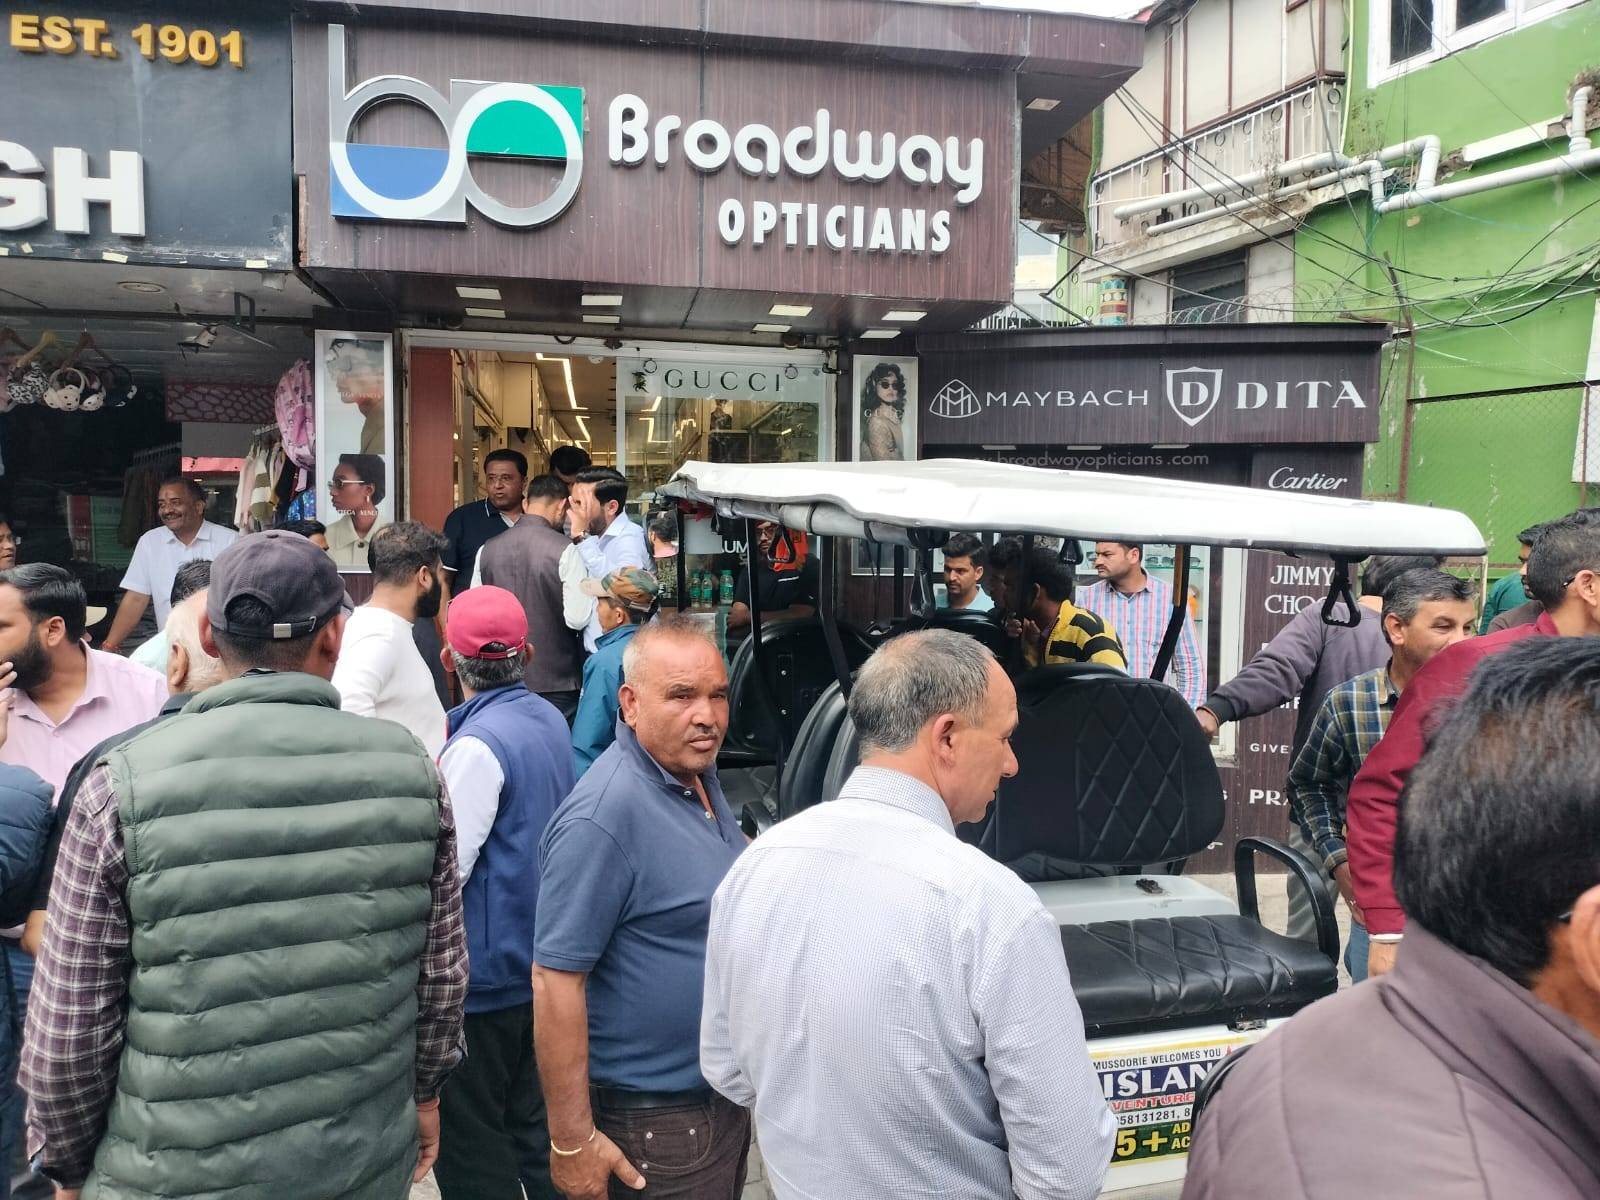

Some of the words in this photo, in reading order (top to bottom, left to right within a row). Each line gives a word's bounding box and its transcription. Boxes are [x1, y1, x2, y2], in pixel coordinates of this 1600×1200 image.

[10, 14, 113, 58] EST.
[131, 23, 245, 68] 1901
[608, 93, 984, 204] Broadway
[718, 198, 952, 252] OPTICIANS
[664, 368, 782, 393] GUCCI
[985, 389, 1149, 408] MAYBACH
[1236, 380, 1368, 410] DITA
[1268, 467, 1348, 491] Cartier
[1270, 565, 1335, 586] JIMMY
[1264, 594, 1328, 615] CHO
[1250, 743, 1293, 754] GIVE
[1093, 1057, 1148, 1071] MUSSOORIE
[1150, 1051, 1201, 1065] WELCOMES
[1204, 1048, 1221, 1058] YOU
[1116, 1110, 1180, 1126] 58131281,
